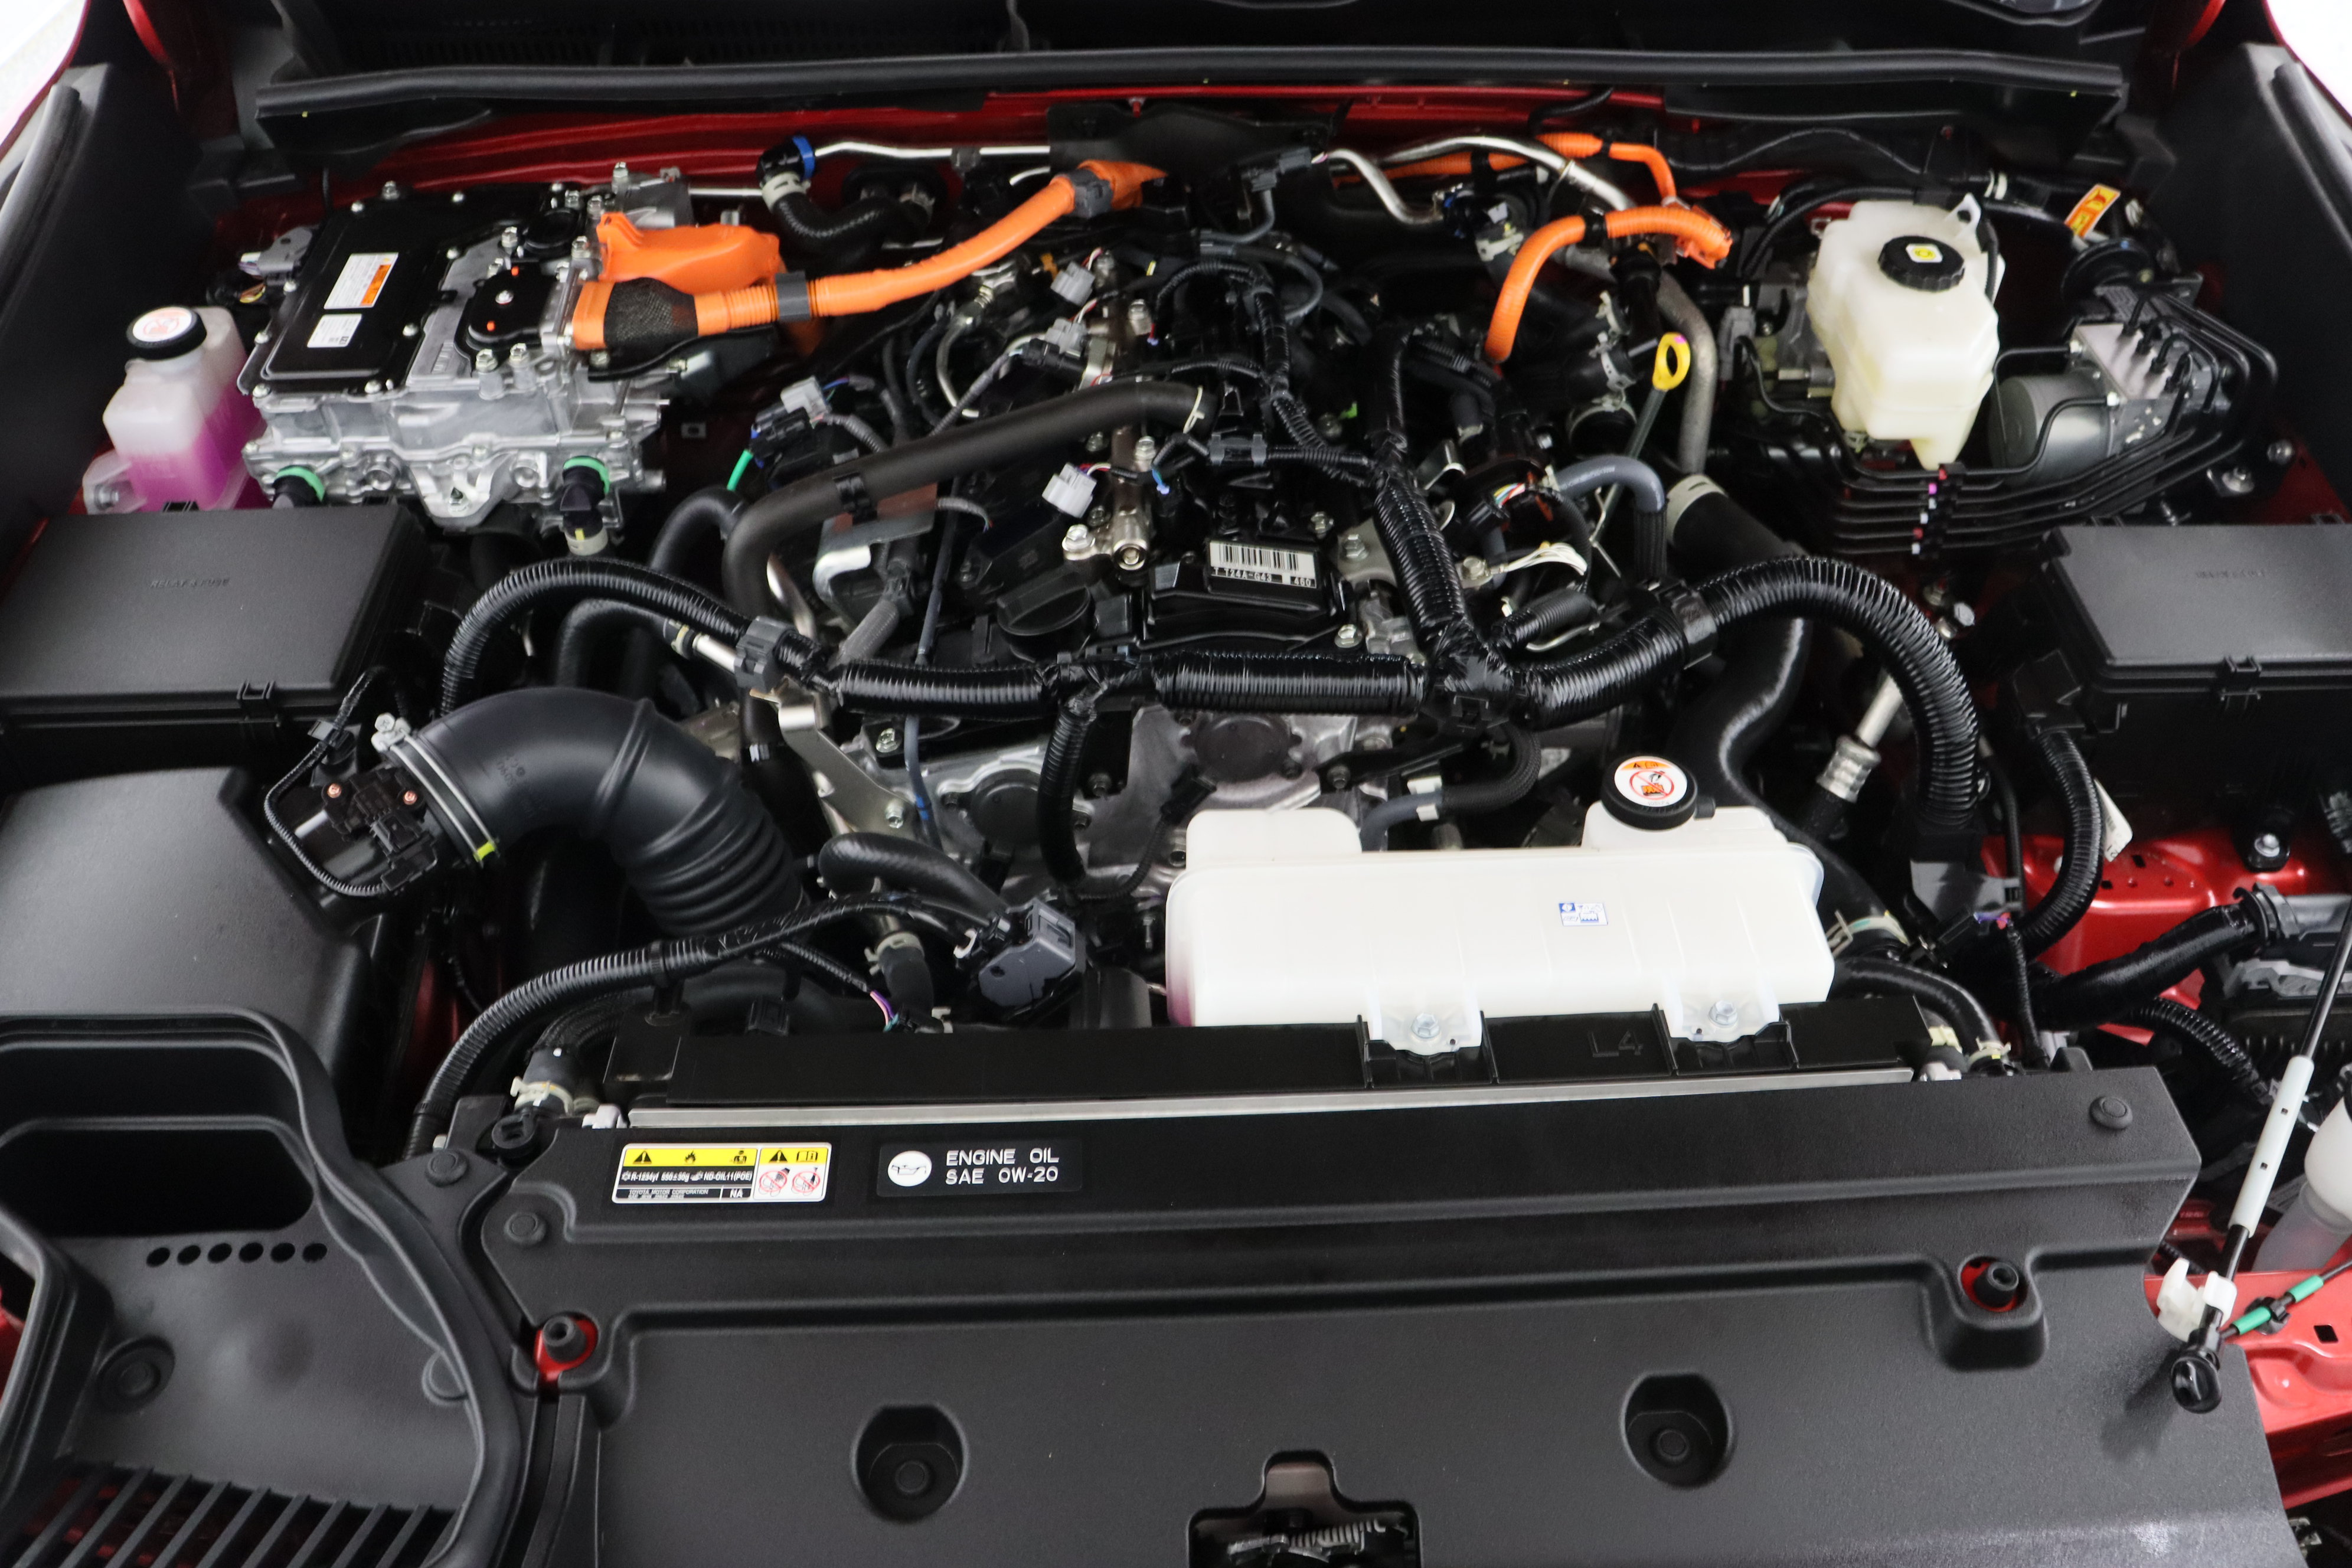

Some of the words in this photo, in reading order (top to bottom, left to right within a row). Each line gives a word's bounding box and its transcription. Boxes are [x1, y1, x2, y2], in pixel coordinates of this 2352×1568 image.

[1587, 1030, 1644, 1057] L4
[946, 1148, 1016, 1166] ENGINE
[1030, 1147, 1060, 1164] OIL
[945, 1168, 985, 1185] SAE
[998, 1166, 1059, 1184] 0W-20
[730, 1188, 743, 1198] NA
